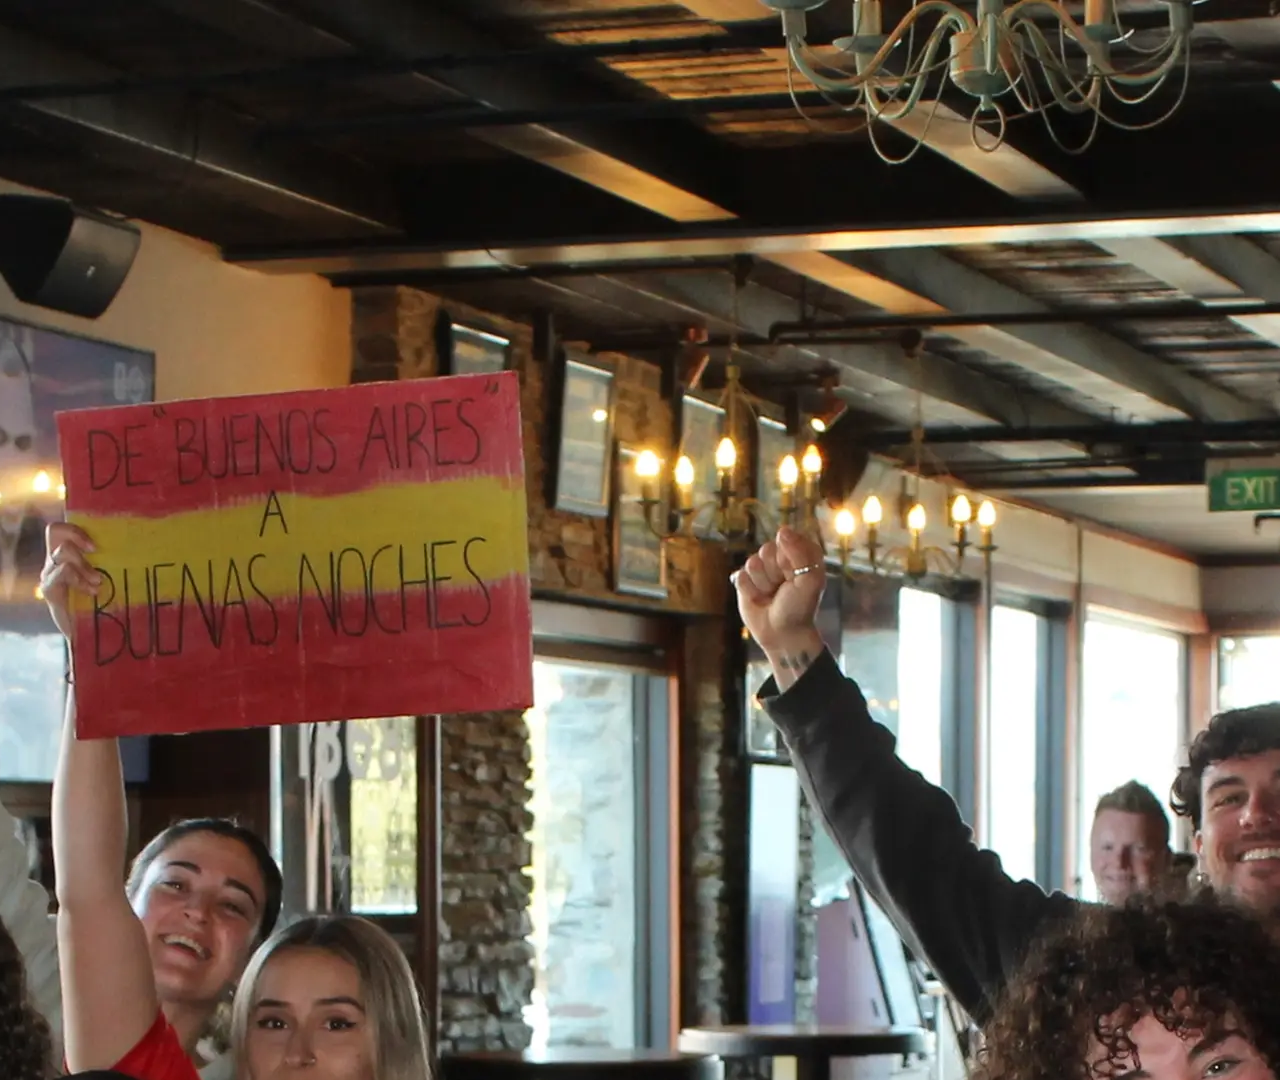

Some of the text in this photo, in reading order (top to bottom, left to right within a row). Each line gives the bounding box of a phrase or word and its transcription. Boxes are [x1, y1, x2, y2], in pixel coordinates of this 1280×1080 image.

[88, 424, 154, 491] DE
[258, 489, 289, 537] A
[1226, 475, 1279, 506] EXIT
[92, 537, 492, 666] BUENAS NOCHES
